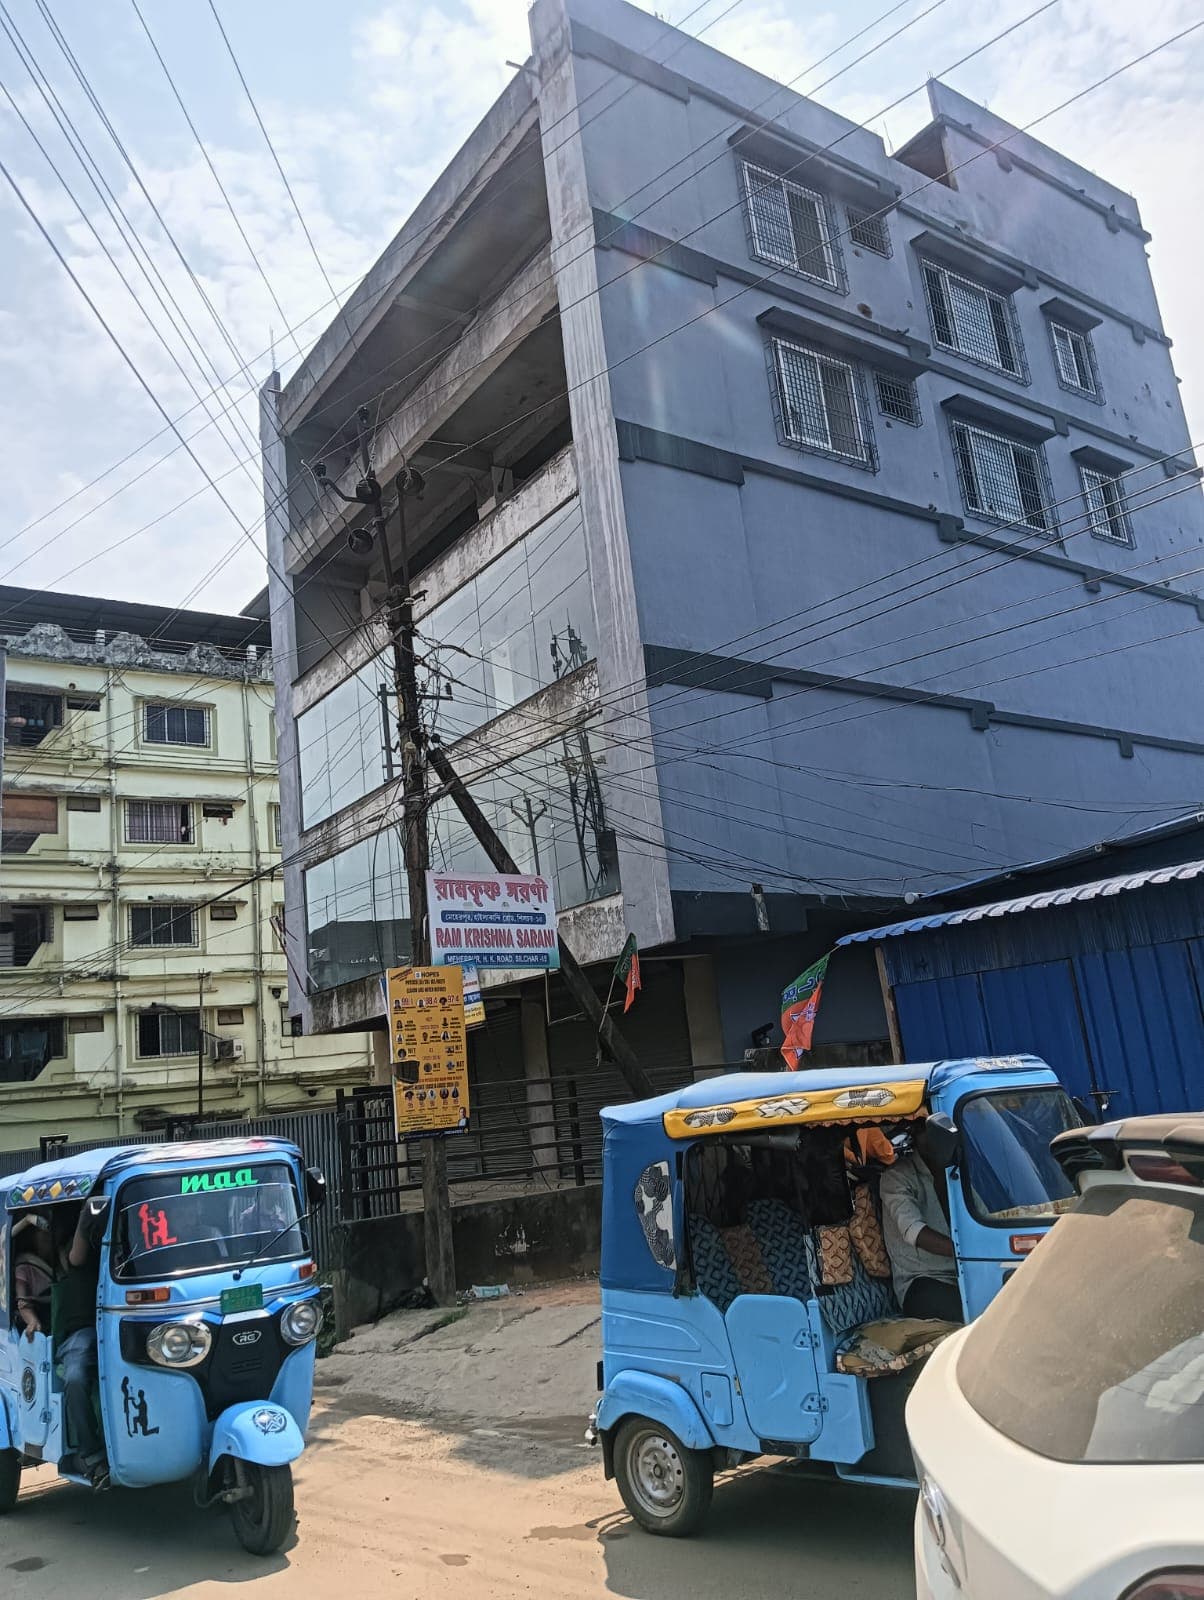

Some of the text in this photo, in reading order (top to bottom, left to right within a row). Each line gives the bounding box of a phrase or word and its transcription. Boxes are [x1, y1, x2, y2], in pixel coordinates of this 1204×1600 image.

[433, 878, 549, 907] রামকৃষ্ণ সরণী
[435, 927, 556, 949] RAM KRISHNA SARANI
[181, 1168, 258, 1194] maa
